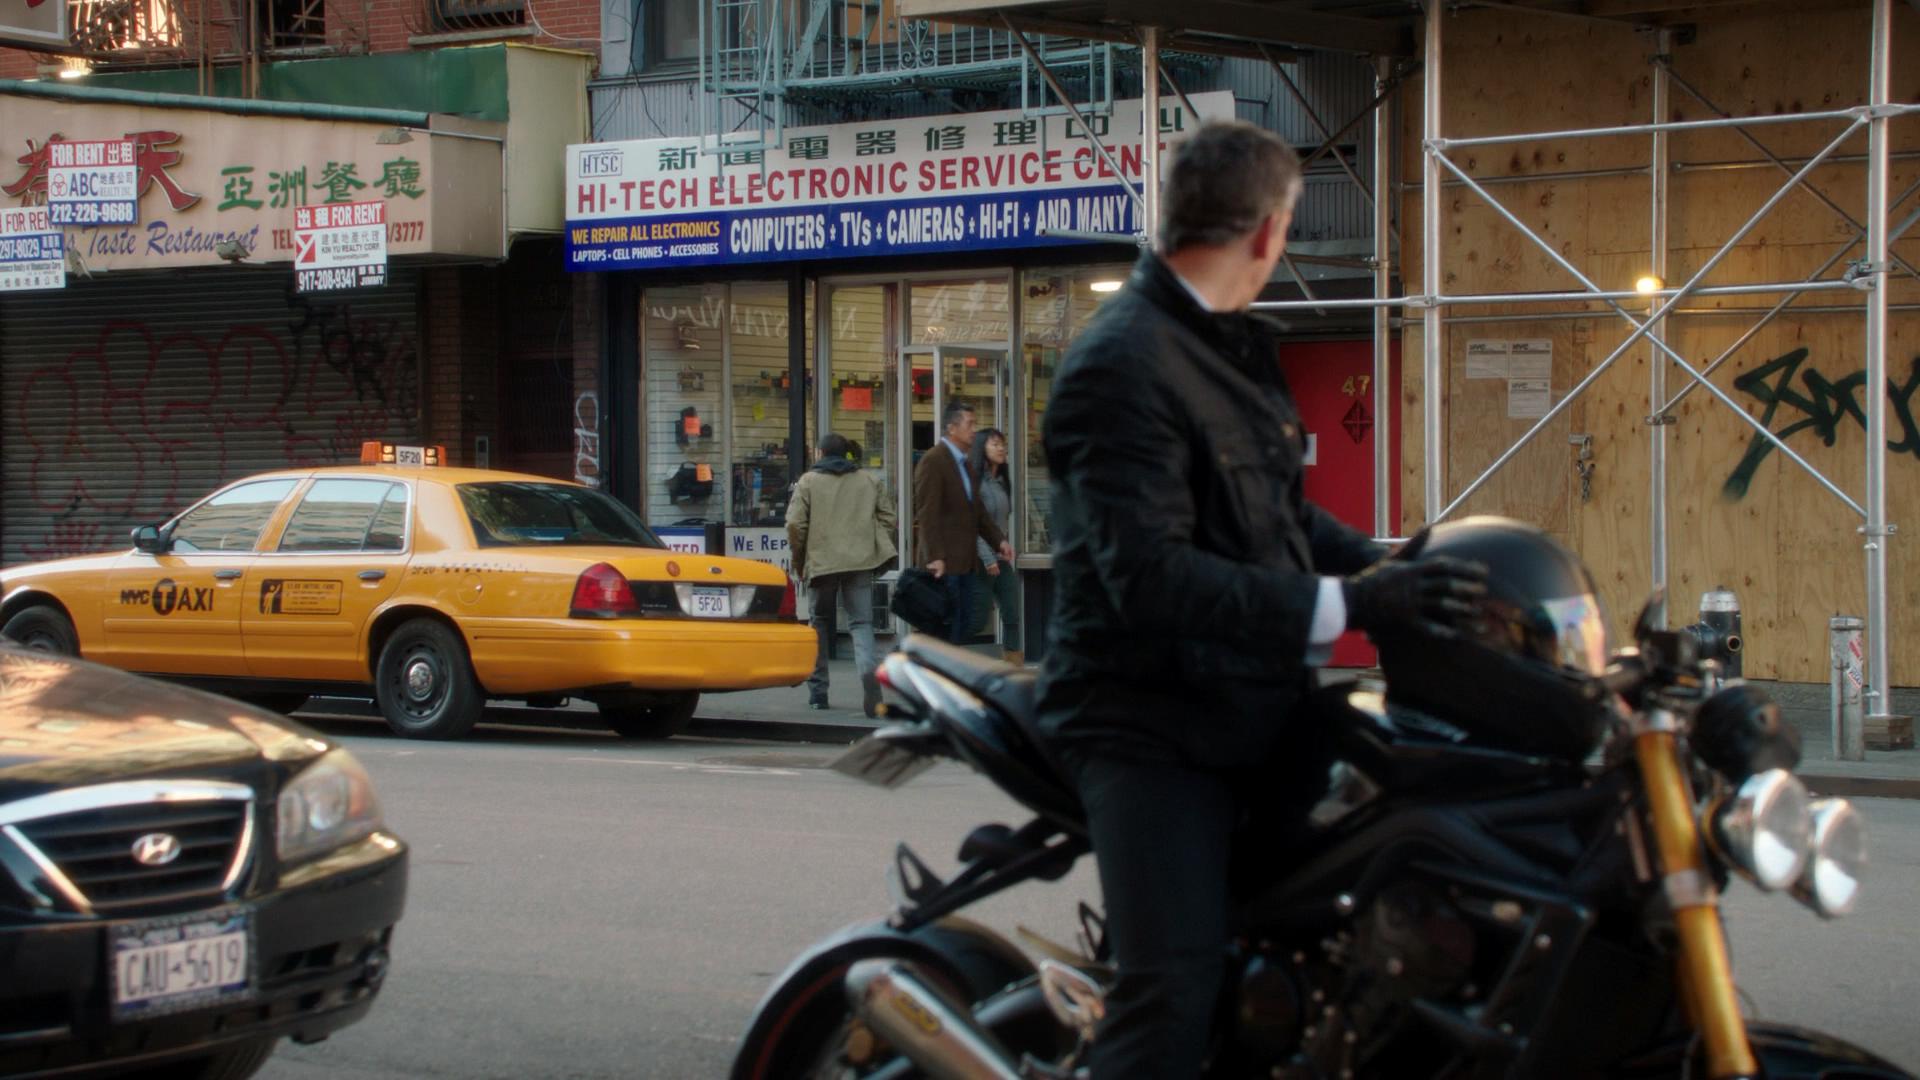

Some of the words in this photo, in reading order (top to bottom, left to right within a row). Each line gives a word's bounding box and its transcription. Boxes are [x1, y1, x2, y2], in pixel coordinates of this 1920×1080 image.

[51, 144, 75, 166] FOR
[76, 142, 105, 165] RENT
[108, 141, 133, 164] 出租
[583, 154, 618, 174] HTSC
[69, 172, 98, 197] ABC
[217, 156, 426, 212] 亞洲餐廳
[578, 177, 698, 214] HI-TECH
[709, 161, 908, 206] ELECTRONIC
[918, 150, 1062, 193] SERVICE
[1073, 142, 1167, 180] CEN
[6, 213, 26, 233] FOR
[51, 202, 133, 222] 212-226-9688
[332, 205, 353, 226] FOR
[353, 202, 382, 225] RENT
[731, 214, 825, 253] COMPUTERS
[840, 211, 871, 247] TVs
[886, 205, 964, 245] CAMERAS
[980, 201, 1019, 239] HI-FI
[1035, 199, 1071, 236] AND
[1077, 194, 1128, 233] MANY
[82, 227, 137, 258] Taste
[572, 228, 589, 245] WE
[591, 225, 628, 244] REPAIR
[630, 224, 649, 241] ALL
[651, 220, 720, 240] ELECTRONICS
[573, 249, 607, 263] LAPTOPS
[613, 247, 630, 261] CELL
[632, 246, 663, 259] PHONES
[669, 242, 719, 257] ACCESSORIES
[298, 268, 357, 291] 917-208-9341
[1341, 375, 1371, 396] 47
[400, 450, 421, 464] 5F20
[120, 589, 150, 605] NYC
[152, 578, 214, 616] TAXI
[698, 596, 723, 612] 5F20
